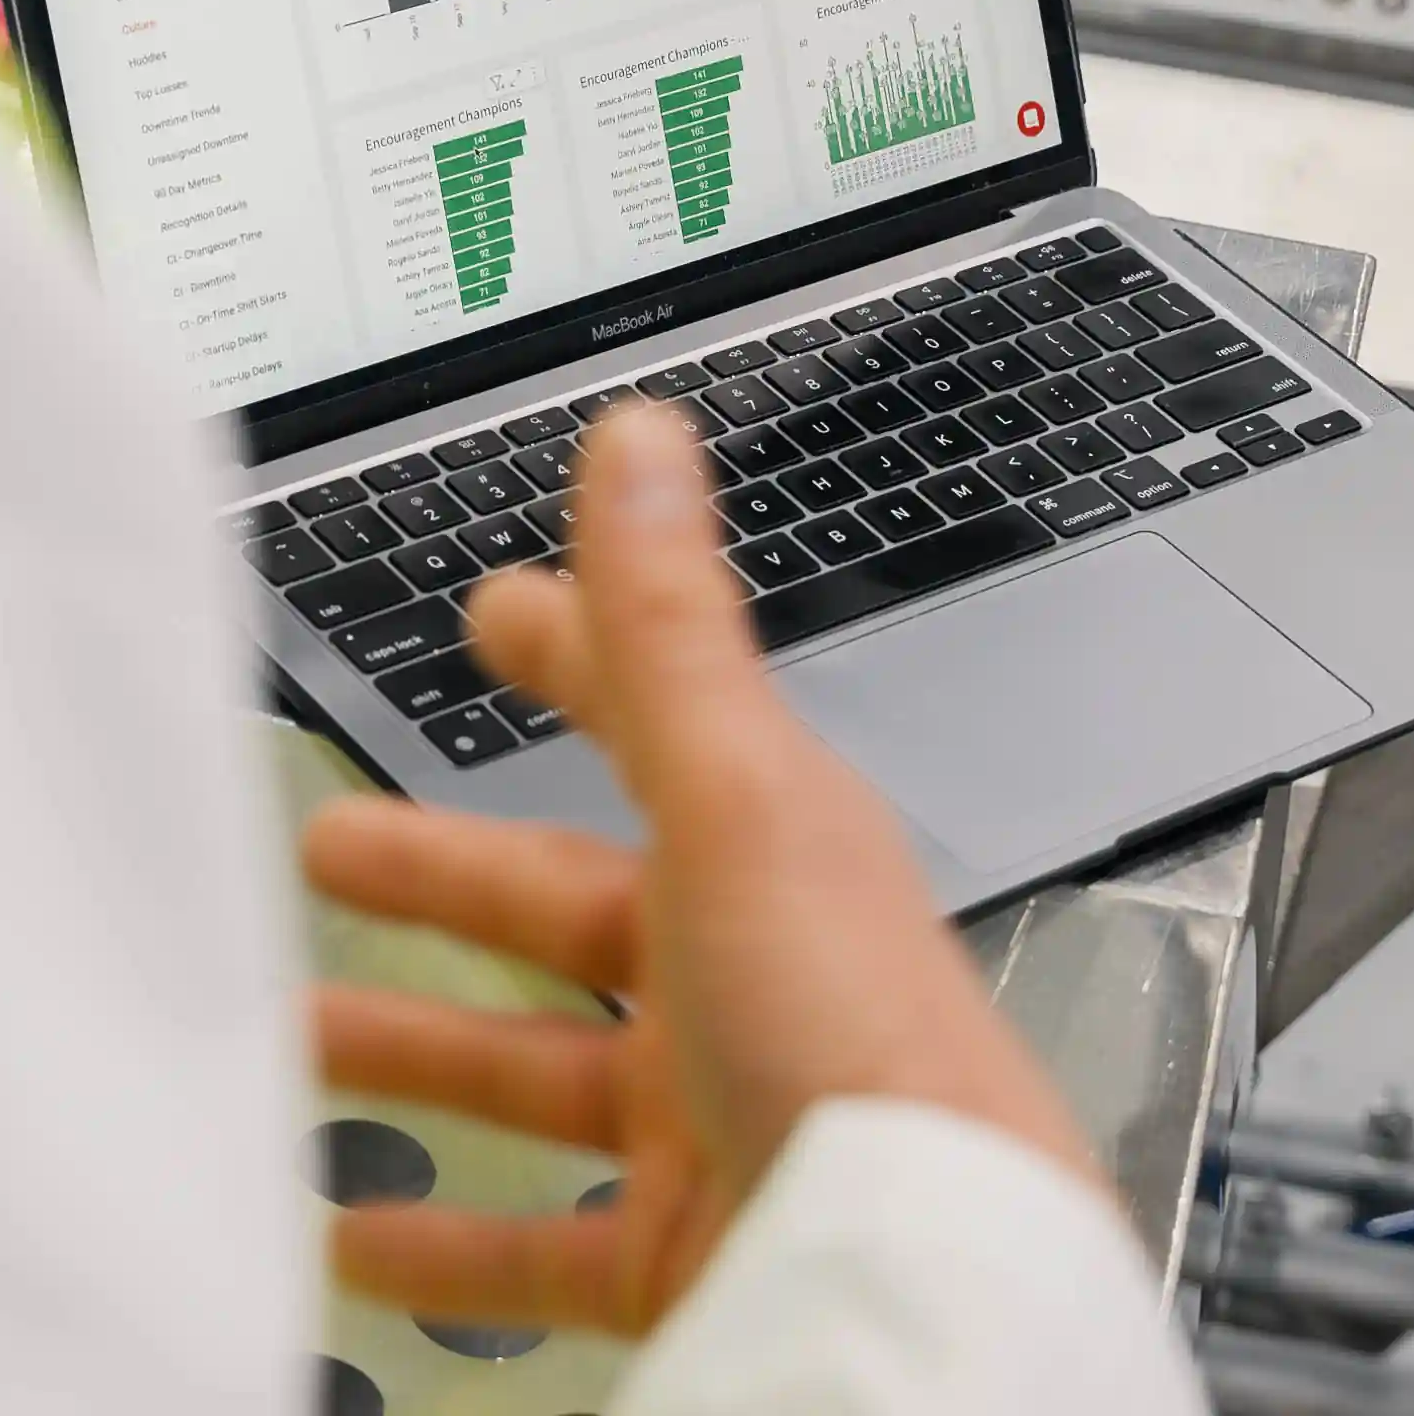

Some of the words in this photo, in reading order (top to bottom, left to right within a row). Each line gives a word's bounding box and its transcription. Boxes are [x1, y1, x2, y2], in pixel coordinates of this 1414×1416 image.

[121, 19, 157, 36] Culture
[128, 50, 167, 69] Huddles
[579, 55, 666, 89] Encouragement
[667, 36, 729, 63] Champions
[693, 70, 707, 81] 141
[134, 90, 153, 101] Top
[154, 79, 190, 96] Losses
[693, 88, 707, 98] 132
[141, 113, 188, 134] Downtime
[190, 103, 221, 120] Trends
[690, 107, 704, 118] 109
[365, 115, 456, 152] Encouragement
[458, 97, 523, 125] Champions
[690, 126, 704, 137] 102
[473, 134, 488, 146] 141
[147, 143, 202, 167] Unassigned
[202, 130, 249, 152] Downtime
[693, 143, 707, 154] 101
[369, 162, 398, 177] Jessica
[696, 162, 707, 172] 93
[168, 182, 186, 197] Day
[187, 172, 222, 190] Metrics
[371, 181, 391, 196] Betty
[392, 170, 434, 188] Hernandez
[469, 173, 484, 185] 109
[698, 180, 709, 190] 92
[470, 192, 485, 205] 102
[698, 198, 709, 209] 82
[160, 209, 215, 234] Recognition
[216, 199, 248, 217] Details
[414, 207, 440, 224] Jordan
[473, 210, 488, 222] 101
[698, 217, 708, 227] 71
[476, 229, 487, 241] 93
[184, 237, 238, 261] Changeover
[240, 229, 263, 244] Time
[479, 247, 490, 259] 92
[479, 267, 490, 278] 82
[1120, 269, 1154, 285] delete
[190, 271, 237, 294] Downtime
[479, 287, 489, 297] 71
[197, 306, 236, 326] On-Time
[237, 297, 259, 314] Shift
[260, 289, 288, 306] Starts
[591, 310, 655, 343] MacBook
[655, 302, 676, 326] Air
[202, 340, 237, 357] Startup
[238, 330, 269, 347] Delays
[924, 338, 940, 349] 0
[1215, 341, 1250, 357] return
[865, 358, 881, 369] 9
[991, 359, 1005, 371] P
[209, 369, 251, 390] Ramp-Up
[252, 359, 283, 378] Delays
[804, 378, 821, 390] 8
[934, 380, 951, 392] O
[1271, 378, 1298, 393] shift
[731, 388, 745, 398] &
[742, 399, 756, 411] 7
[876, 401, 889, 412] I
[995, 414, 1013, 425] L
[682, 421, 698, 433] 6
[812, 421, 830, 434] U
[934, 433, 954, 446] K
[750, 442, 766, 455] Y
[542, 452, 554, 462] $
[880, 455, 892, 468] J
[557, 464, 571, 475] 4
[811, 476, 832, 491] H
[1137, 481, 1173, 499] option
[489, 486, 506, 499] 3
[950, 484, 973, 498] M
[750, 500, 768, 513] G
[423, 508, 441, 521] 2
[560, 509, 579, 523] E
[890, 506, 911, 521] N
[1062, 500, 1116, 528] command
[356, 532, 370, 544] 1
[489, 530, 512, 546] W
[827, 530, 847, 543] B
[426, 555, 447, 569] Q
[763, 551, 781, 565] V
[556, 568, 574, 582] S
[318, 604, 343, 618] tab
[364, 642, 395, 663] caps
[394, 633, 425, 653] lock
[411, 689, 443, 707] shift
[464, 710, 482, 721] fn
